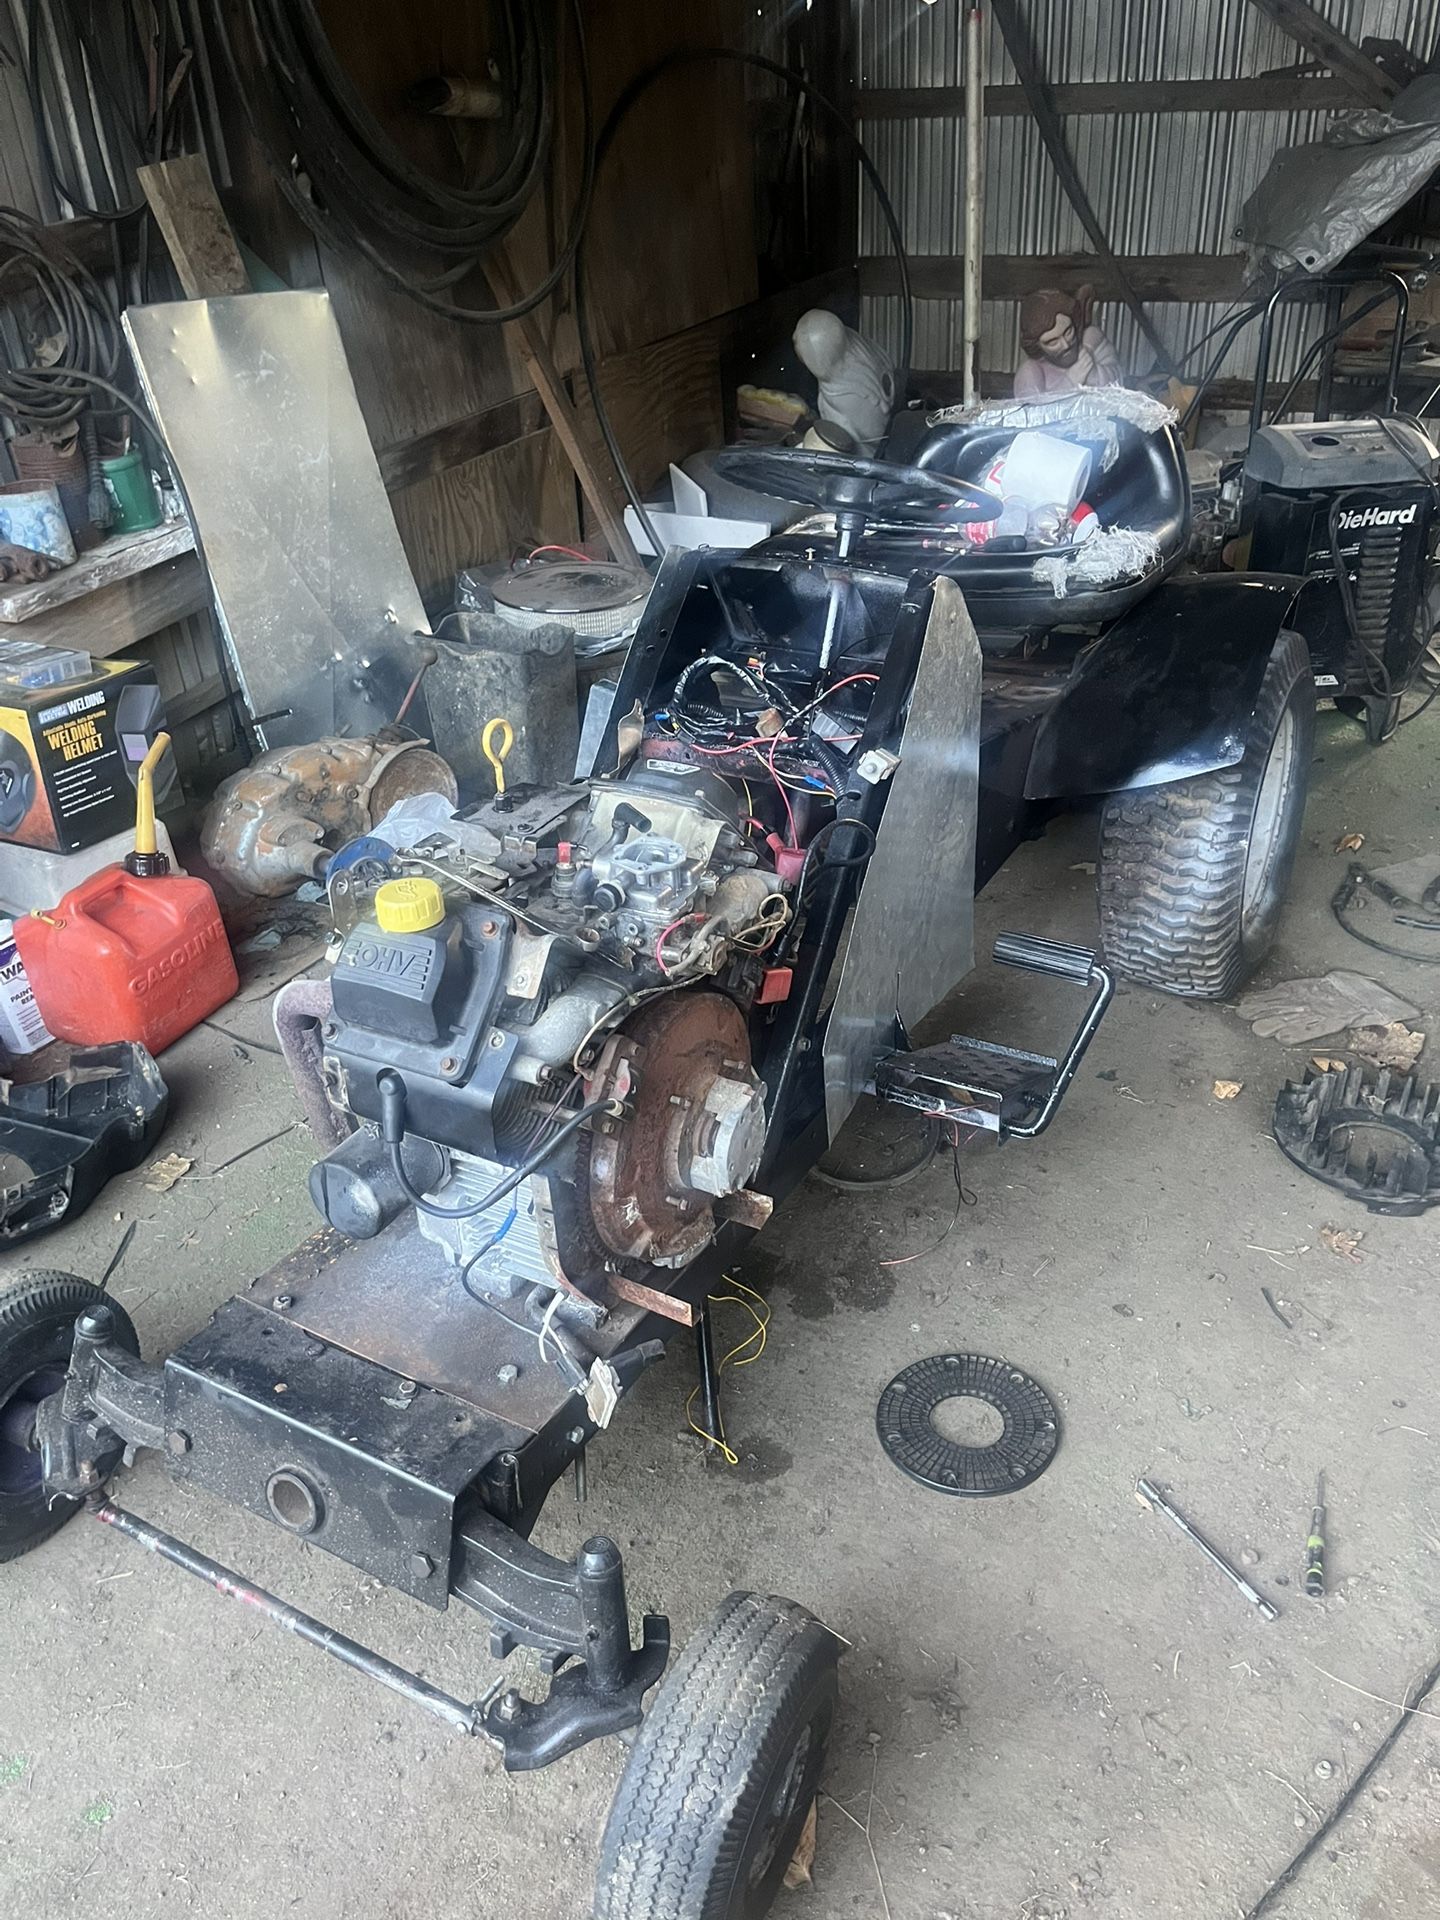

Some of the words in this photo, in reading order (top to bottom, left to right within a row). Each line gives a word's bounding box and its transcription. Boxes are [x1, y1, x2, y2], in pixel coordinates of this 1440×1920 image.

[66, 690, 106, 715] WELDING
[48, 720, 97, 750] WELDING
[63, 733, 104, 761] HELMET
[128, 918, 224, 996] GASOLINE
